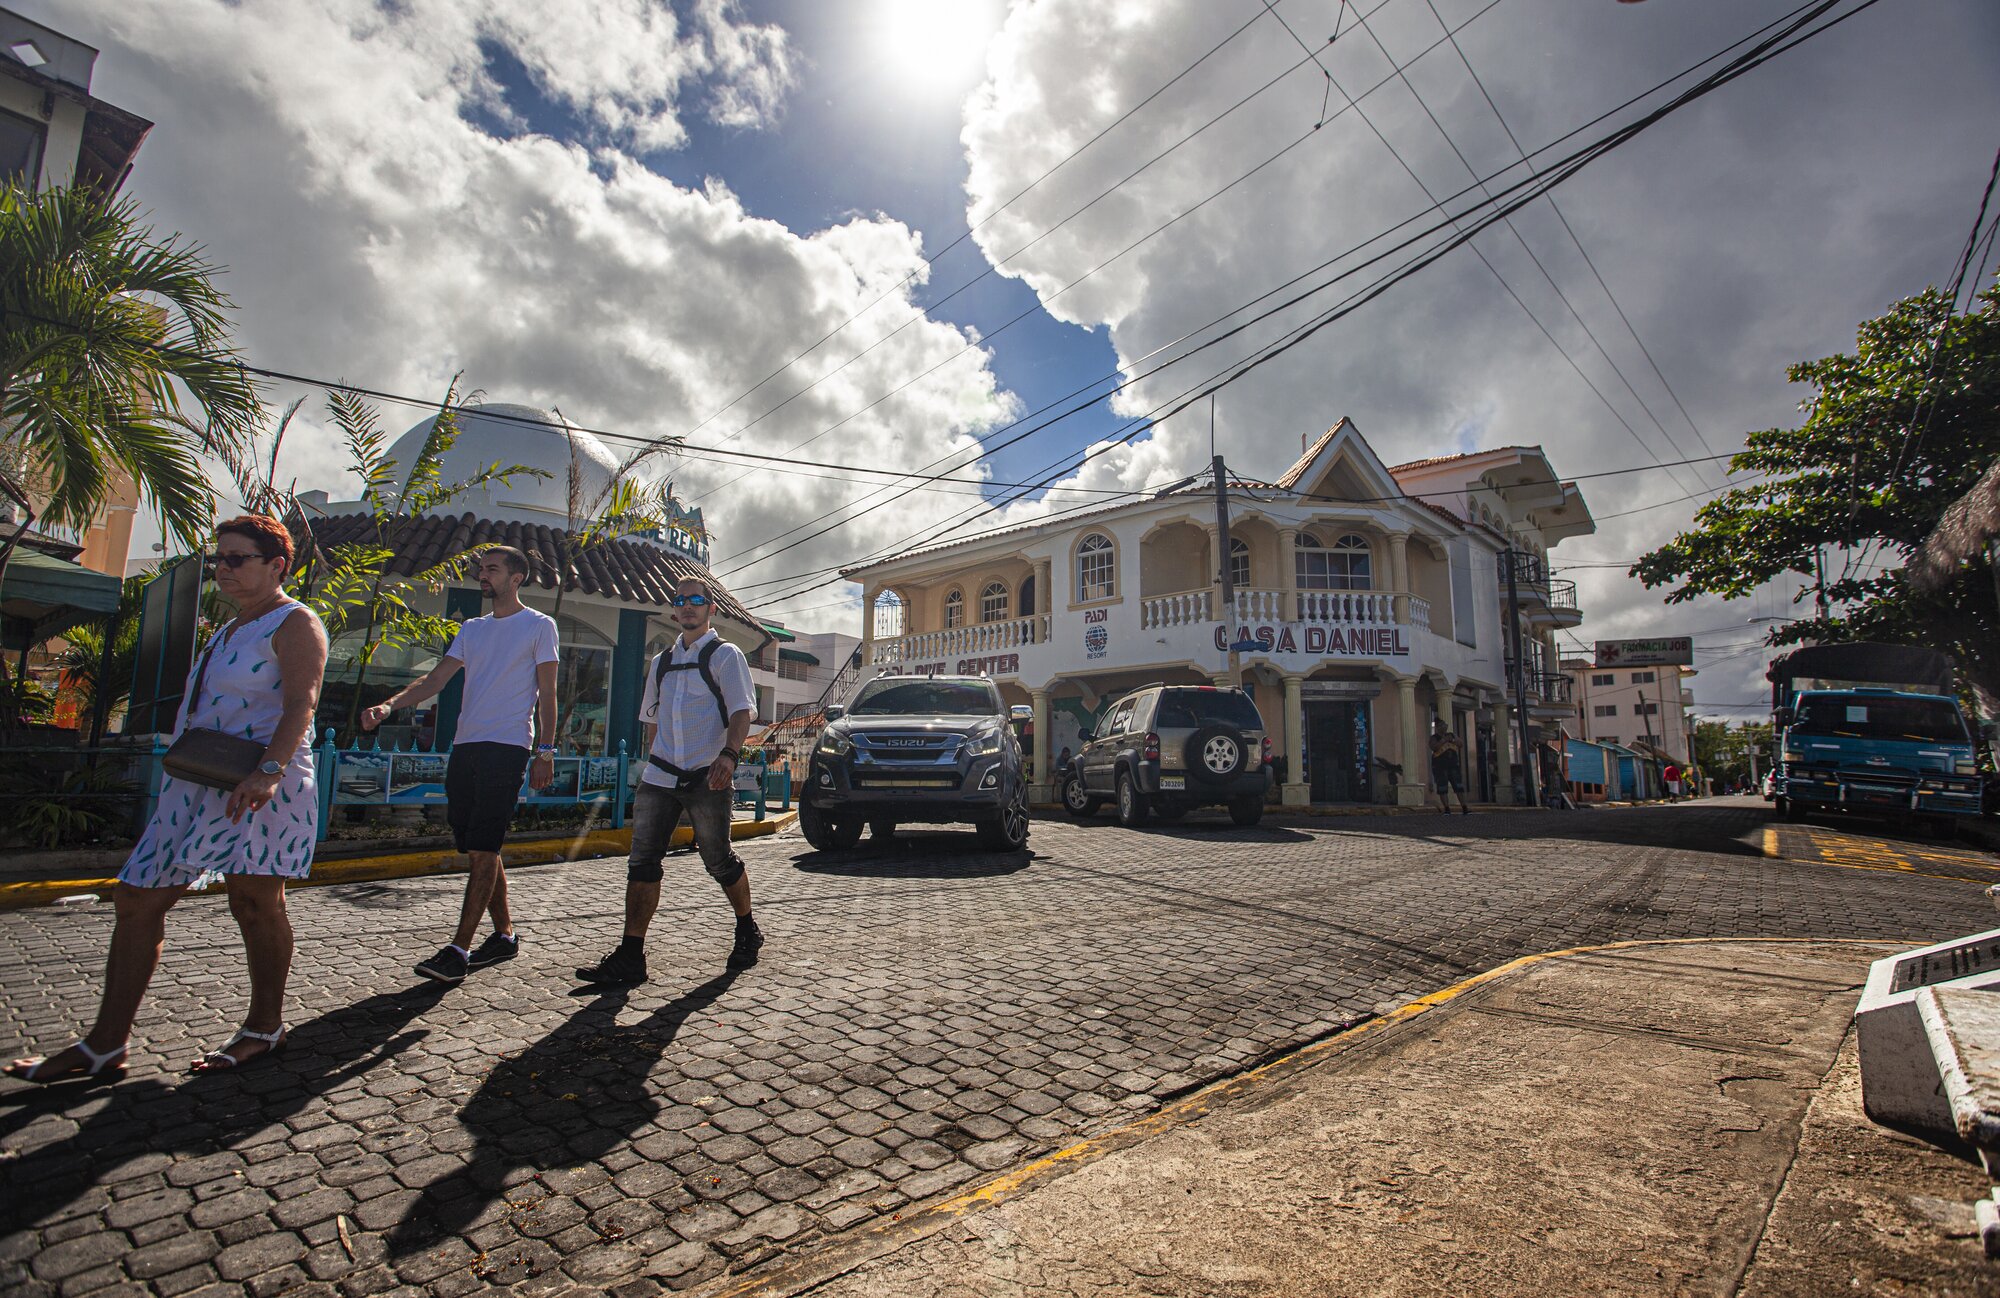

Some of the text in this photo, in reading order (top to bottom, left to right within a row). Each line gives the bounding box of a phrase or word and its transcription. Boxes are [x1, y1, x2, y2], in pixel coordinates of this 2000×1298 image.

[1085, 609, 1108, 624] PADI
[1215, 625, 1297, 653] CASA
[1305, 627, 1410, 656] DANIEL
[1621, 641, 1688, 653] FARMACIA JOB
[1087, 651, 1108, 660] RESORT
[914, 662, 946, 676] DIVE
[957, 653, 1020, 677] CENTER
[887, 739, 925, 747] ISUZU
